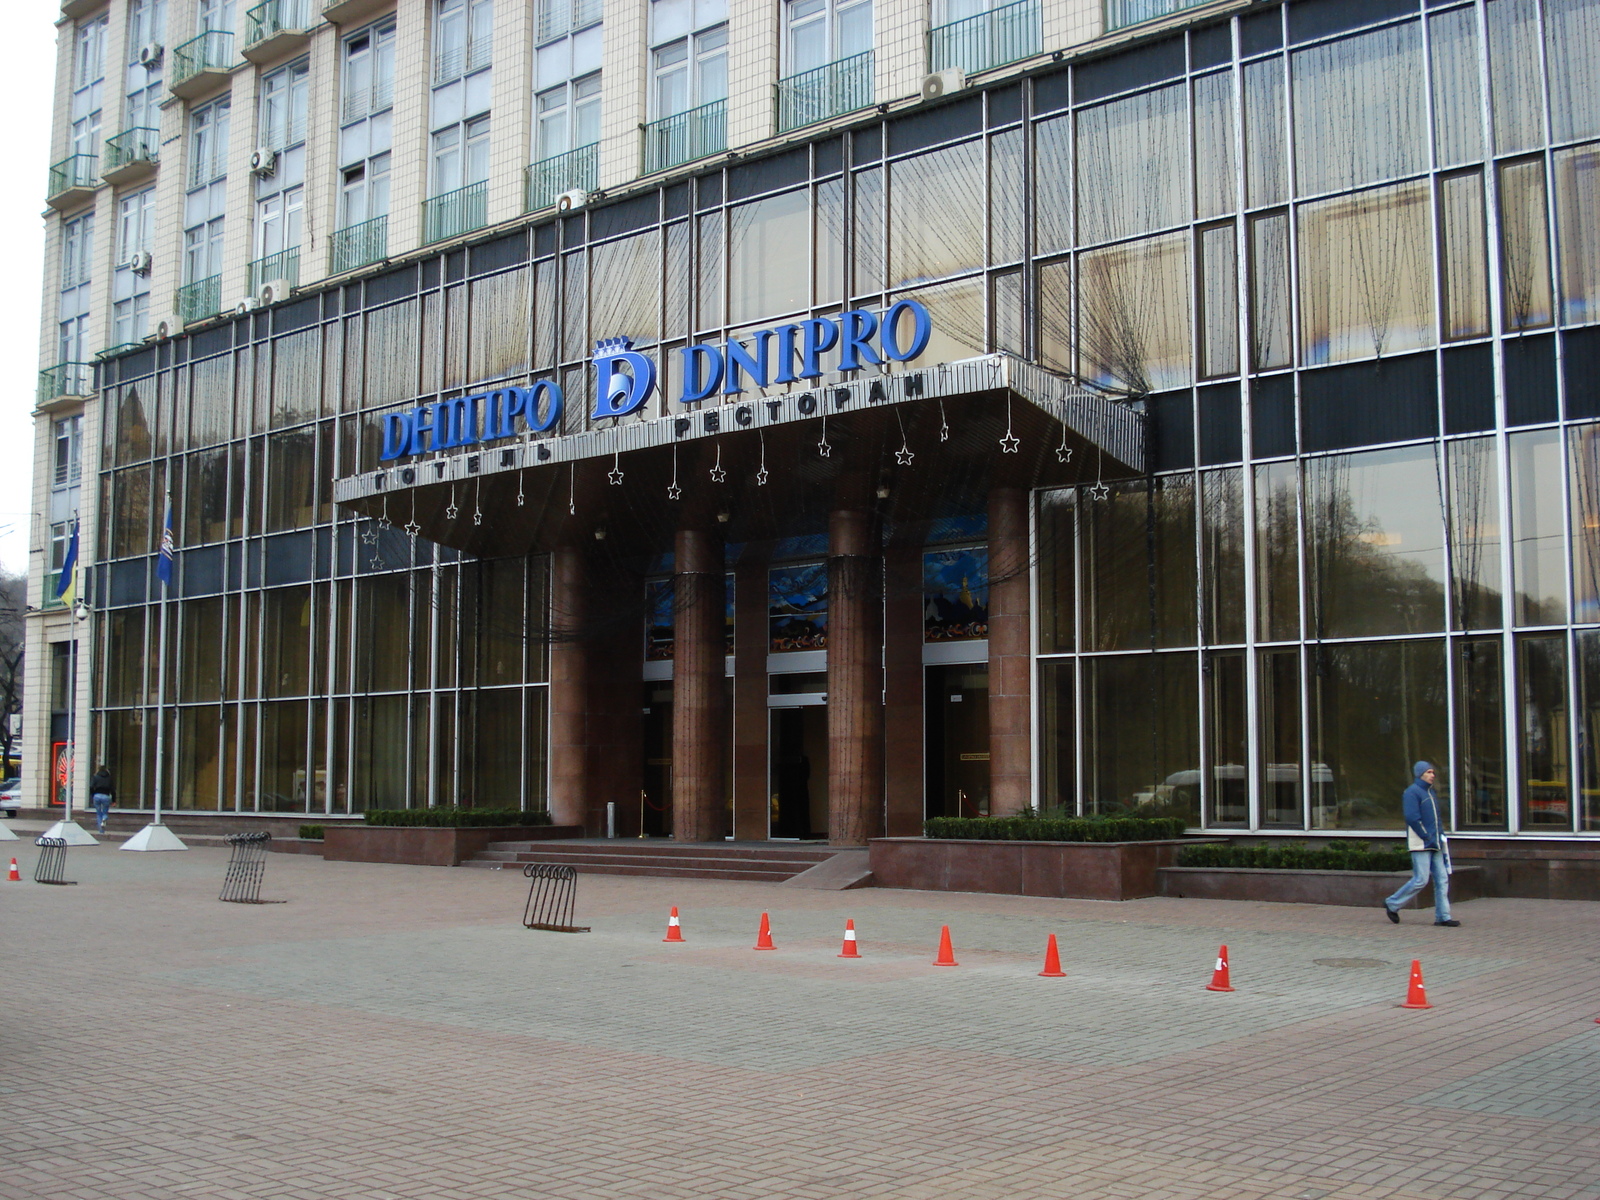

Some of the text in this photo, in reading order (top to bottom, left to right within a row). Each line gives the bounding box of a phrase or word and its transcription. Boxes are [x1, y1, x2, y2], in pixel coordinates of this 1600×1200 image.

[679, 299, 931, 403] DNIPRO
[675, 373, 924, 438] РЕСТОРАН
[375, 444, 550, 490] ГОТЕЛЬ
